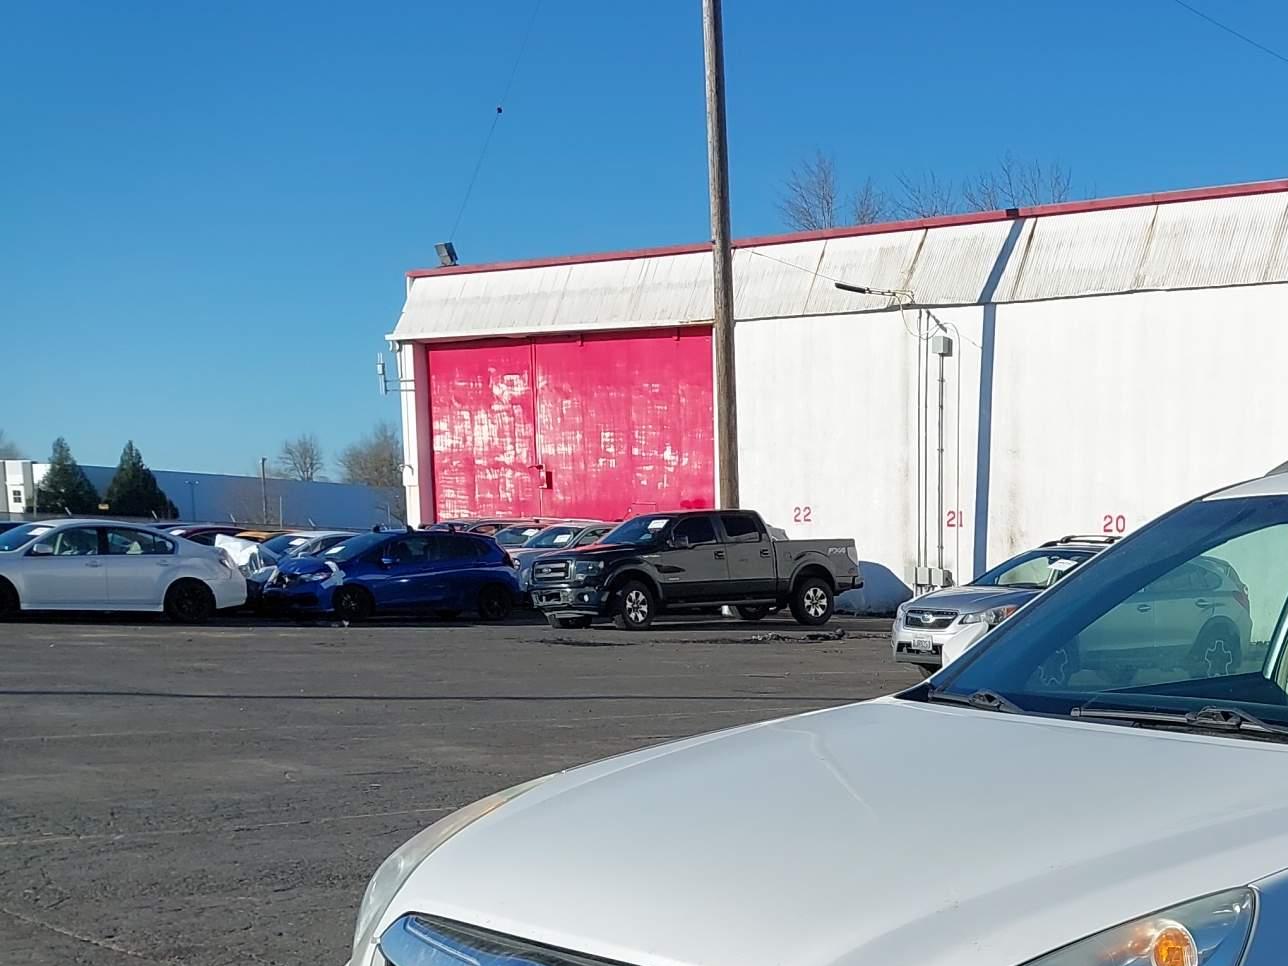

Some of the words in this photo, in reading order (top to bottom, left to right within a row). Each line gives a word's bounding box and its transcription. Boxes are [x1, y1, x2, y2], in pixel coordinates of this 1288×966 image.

[793, 506, 812, 522] 22
[946, 510, 963, 527] 21
[1103, 514, 1126, 533] 20
